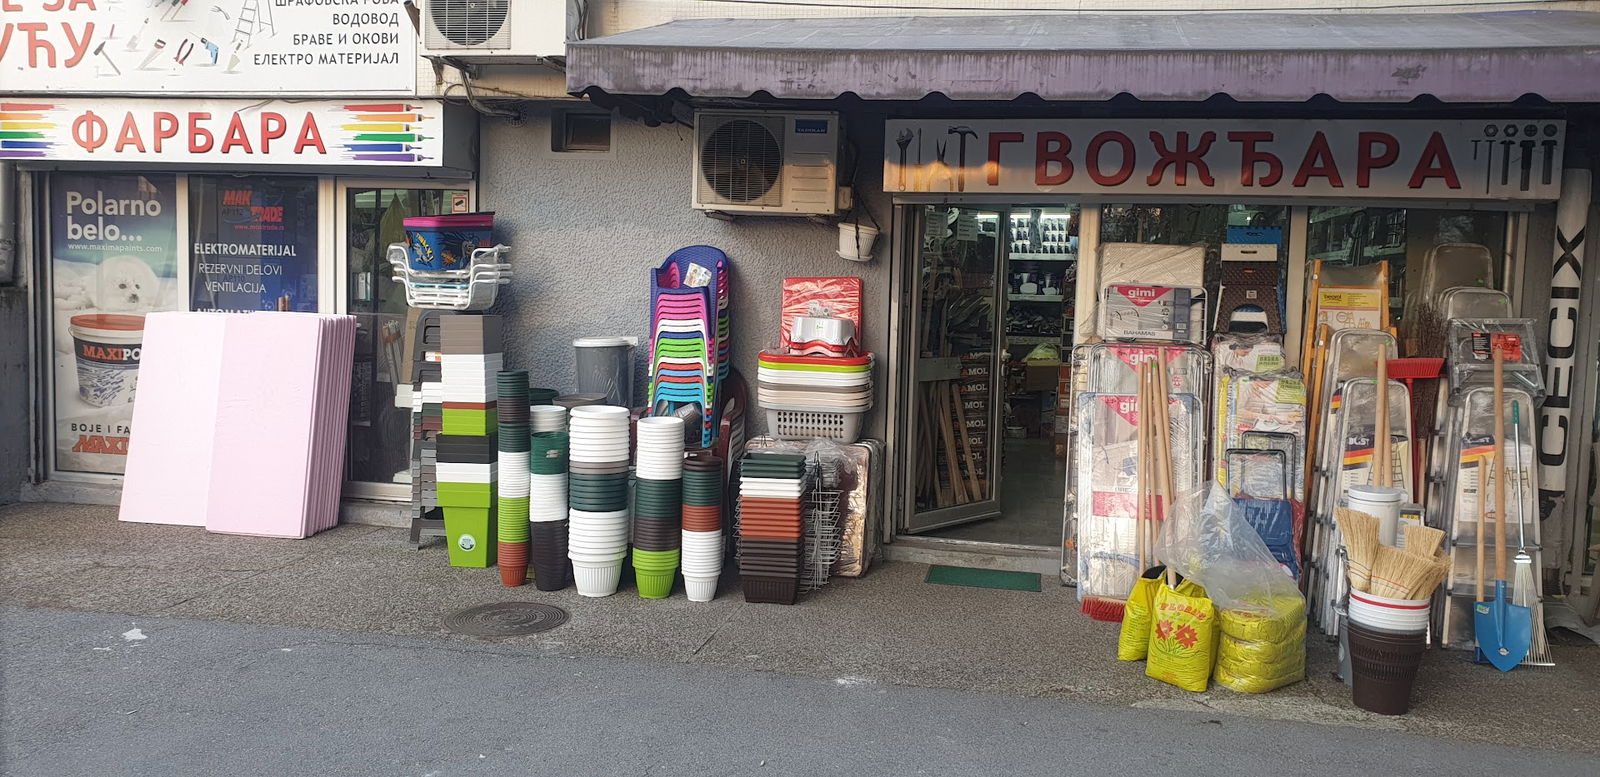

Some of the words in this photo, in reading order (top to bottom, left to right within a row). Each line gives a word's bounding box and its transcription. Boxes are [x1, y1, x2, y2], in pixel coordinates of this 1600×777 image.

[332, 13, 399, 27] ВОДОВОД
[293, 33, 333, 46] БРАВЕ
[338, 33, 347, 45] И
[352, 32, 399, 45] ОКОВИ
[253, 53, 314, 65] ЕЛЕКТРО
[318, 52, 399, 65] МАТЕРИЈАЛ
[71, 110, 327, 155] ФАРБАРА
[986, 129, 1462, 189] ГВОЖЂАРА
[66, 190, 162, 217] Polarno
[67, 215, 142, 241] belo...
[67, 243, 162, 252] www.maximapaints.com
[194, 242, 297, 257] ELEKTROMATERIJAL
[198, 263, 243, 275] REZERVNI
[246, 264, 282, 276] DELOVI
[205, 281, 267, 293] VENTILACIJA
[1128, 288, 1156, 299] gimi
[1130, 350, 1159, 366] gim
[71, 423, 101, 433] BOJE
[107, 425, 111, 433] I
